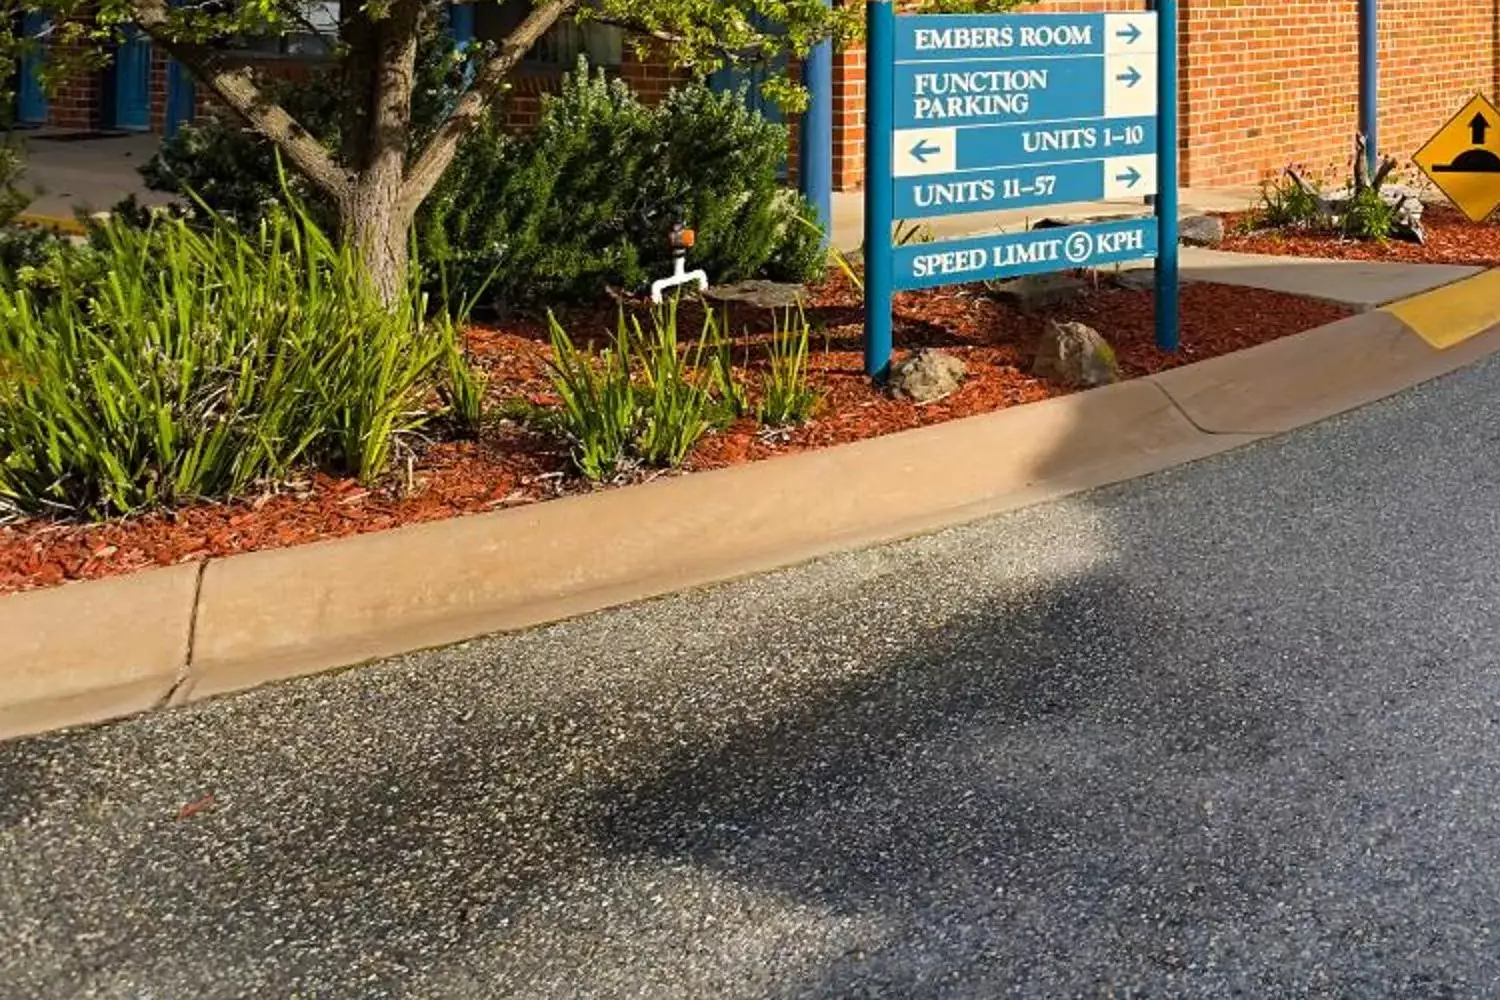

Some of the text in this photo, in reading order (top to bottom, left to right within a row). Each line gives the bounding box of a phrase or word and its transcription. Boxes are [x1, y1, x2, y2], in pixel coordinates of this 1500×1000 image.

[914, 24, 1092, 51] EMBERS ROOM
[914, 69, 1048, 95] FUNCTION
[914, 93, 1029, 119] PARKING
[1022, 127, 1097, 152] UNITS
[913, 179, 995, 207] UNITS
[913, 248, 987, 277] SPEED
[993, 239, 1063, 268] LIMIT
[1096, 229, 1143, 254] KPH
